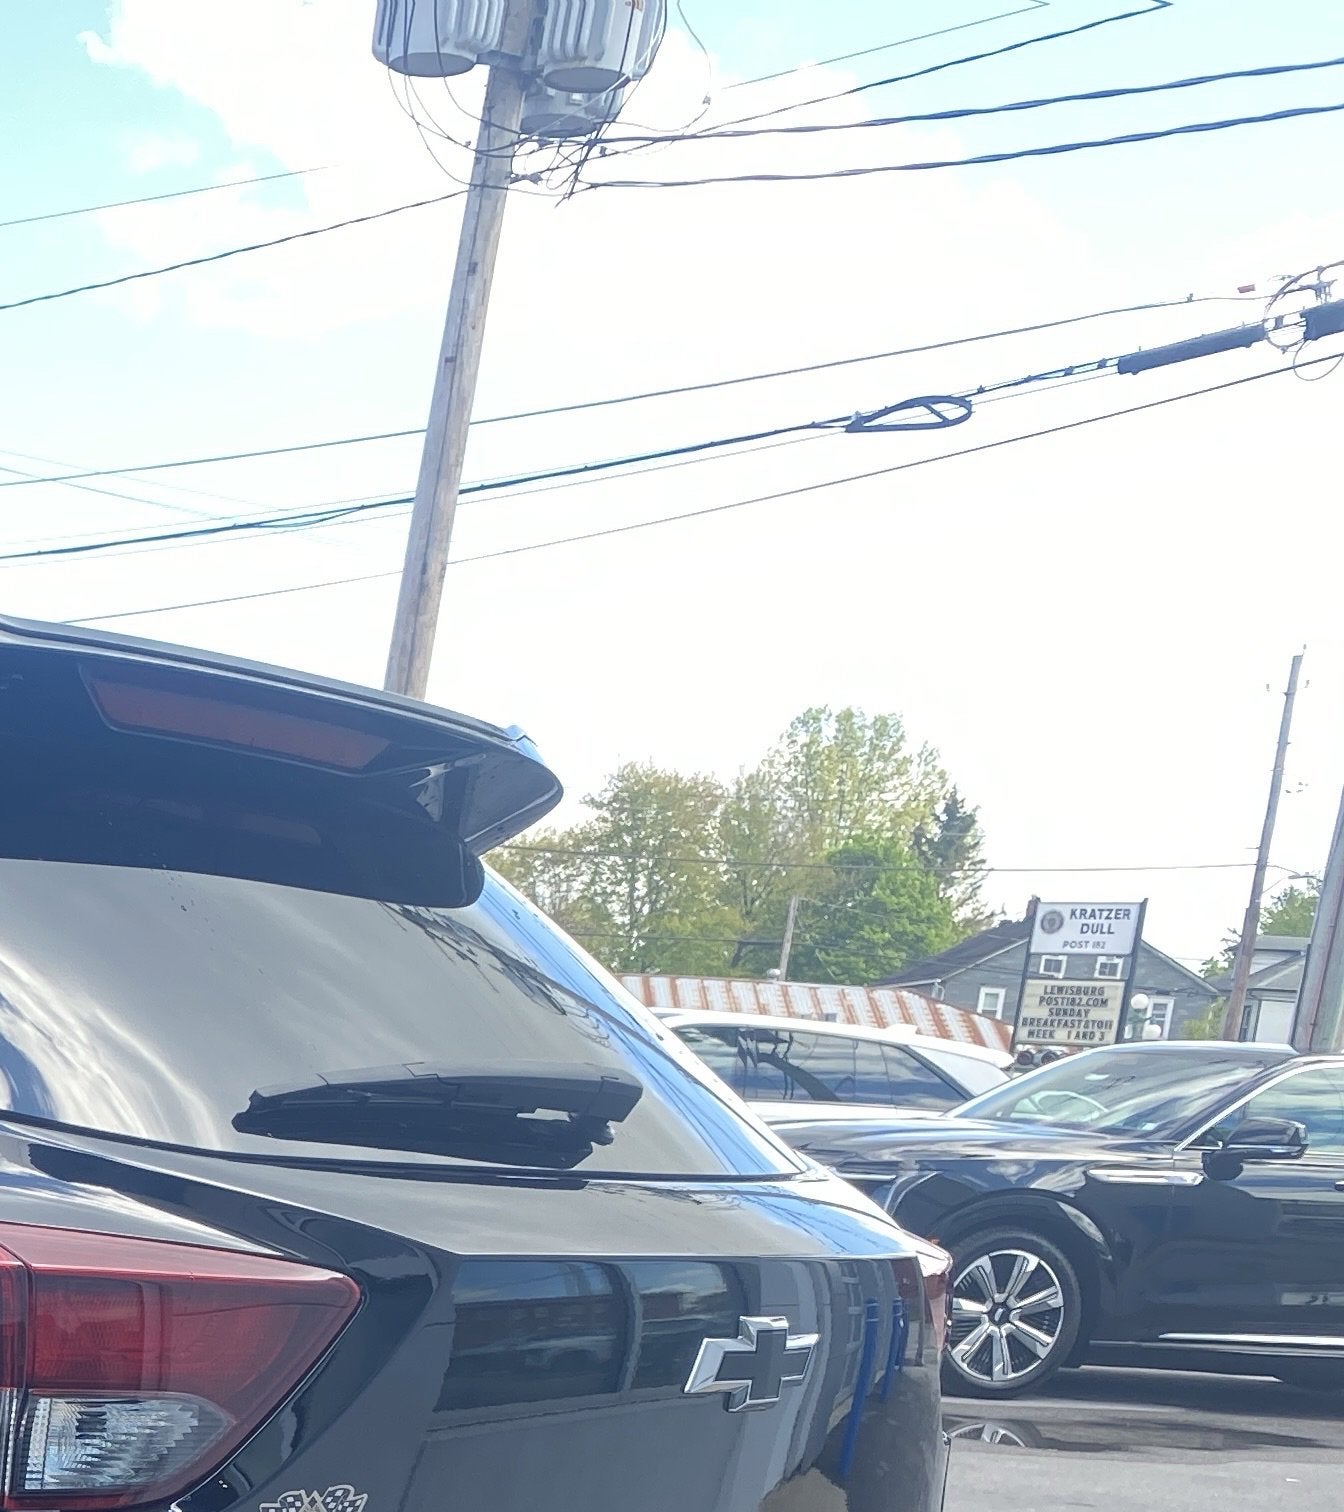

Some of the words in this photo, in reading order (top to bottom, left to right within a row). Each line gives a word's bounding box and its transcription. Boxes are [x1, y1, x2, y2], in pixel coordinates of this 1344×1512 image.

[1069, 908, 1131, 920] KRATZER
[1079, 923, 1115, 934] DULL
[1062, 940, 1090, 949] POST
[1092, 941, 1106, 950] 182
[1043, 985, 1105, 996] LEWISBURG
[1039, 996, 1109, 1008] POST182.COM
[1048, 1007, 1091, 1018] SUNDAY
[1027, 1029, 1056, 1039] WEEK
[1066, 1030, 1072, 1040] 1
[1073, 1031, 1095, 1040] AND
[1098, 1032, 1105, 1041] 3
